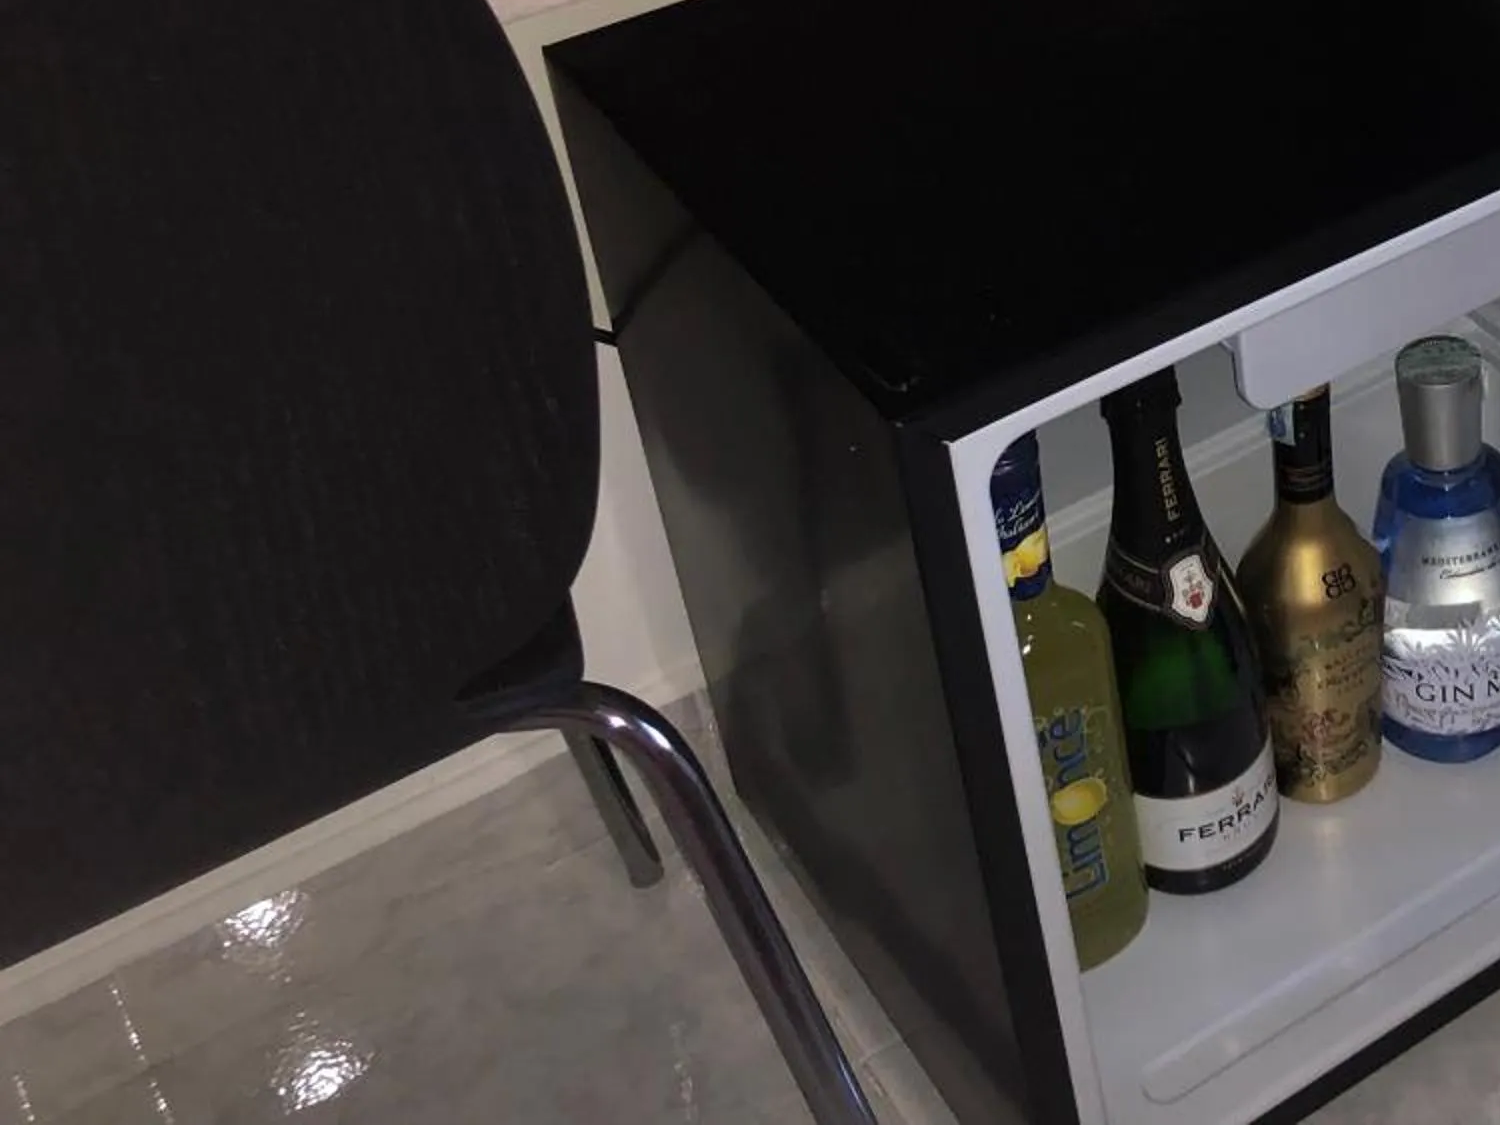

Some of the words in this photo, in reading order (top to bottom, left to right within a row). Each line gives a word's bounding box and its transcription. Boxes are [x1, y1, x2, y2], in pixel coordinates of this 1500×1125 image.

[1155, 437, 1182, 522] FERRARI
[1415, 682, 1475, 704] GIN
[1178, 772, 1276, 843] FERRAR
